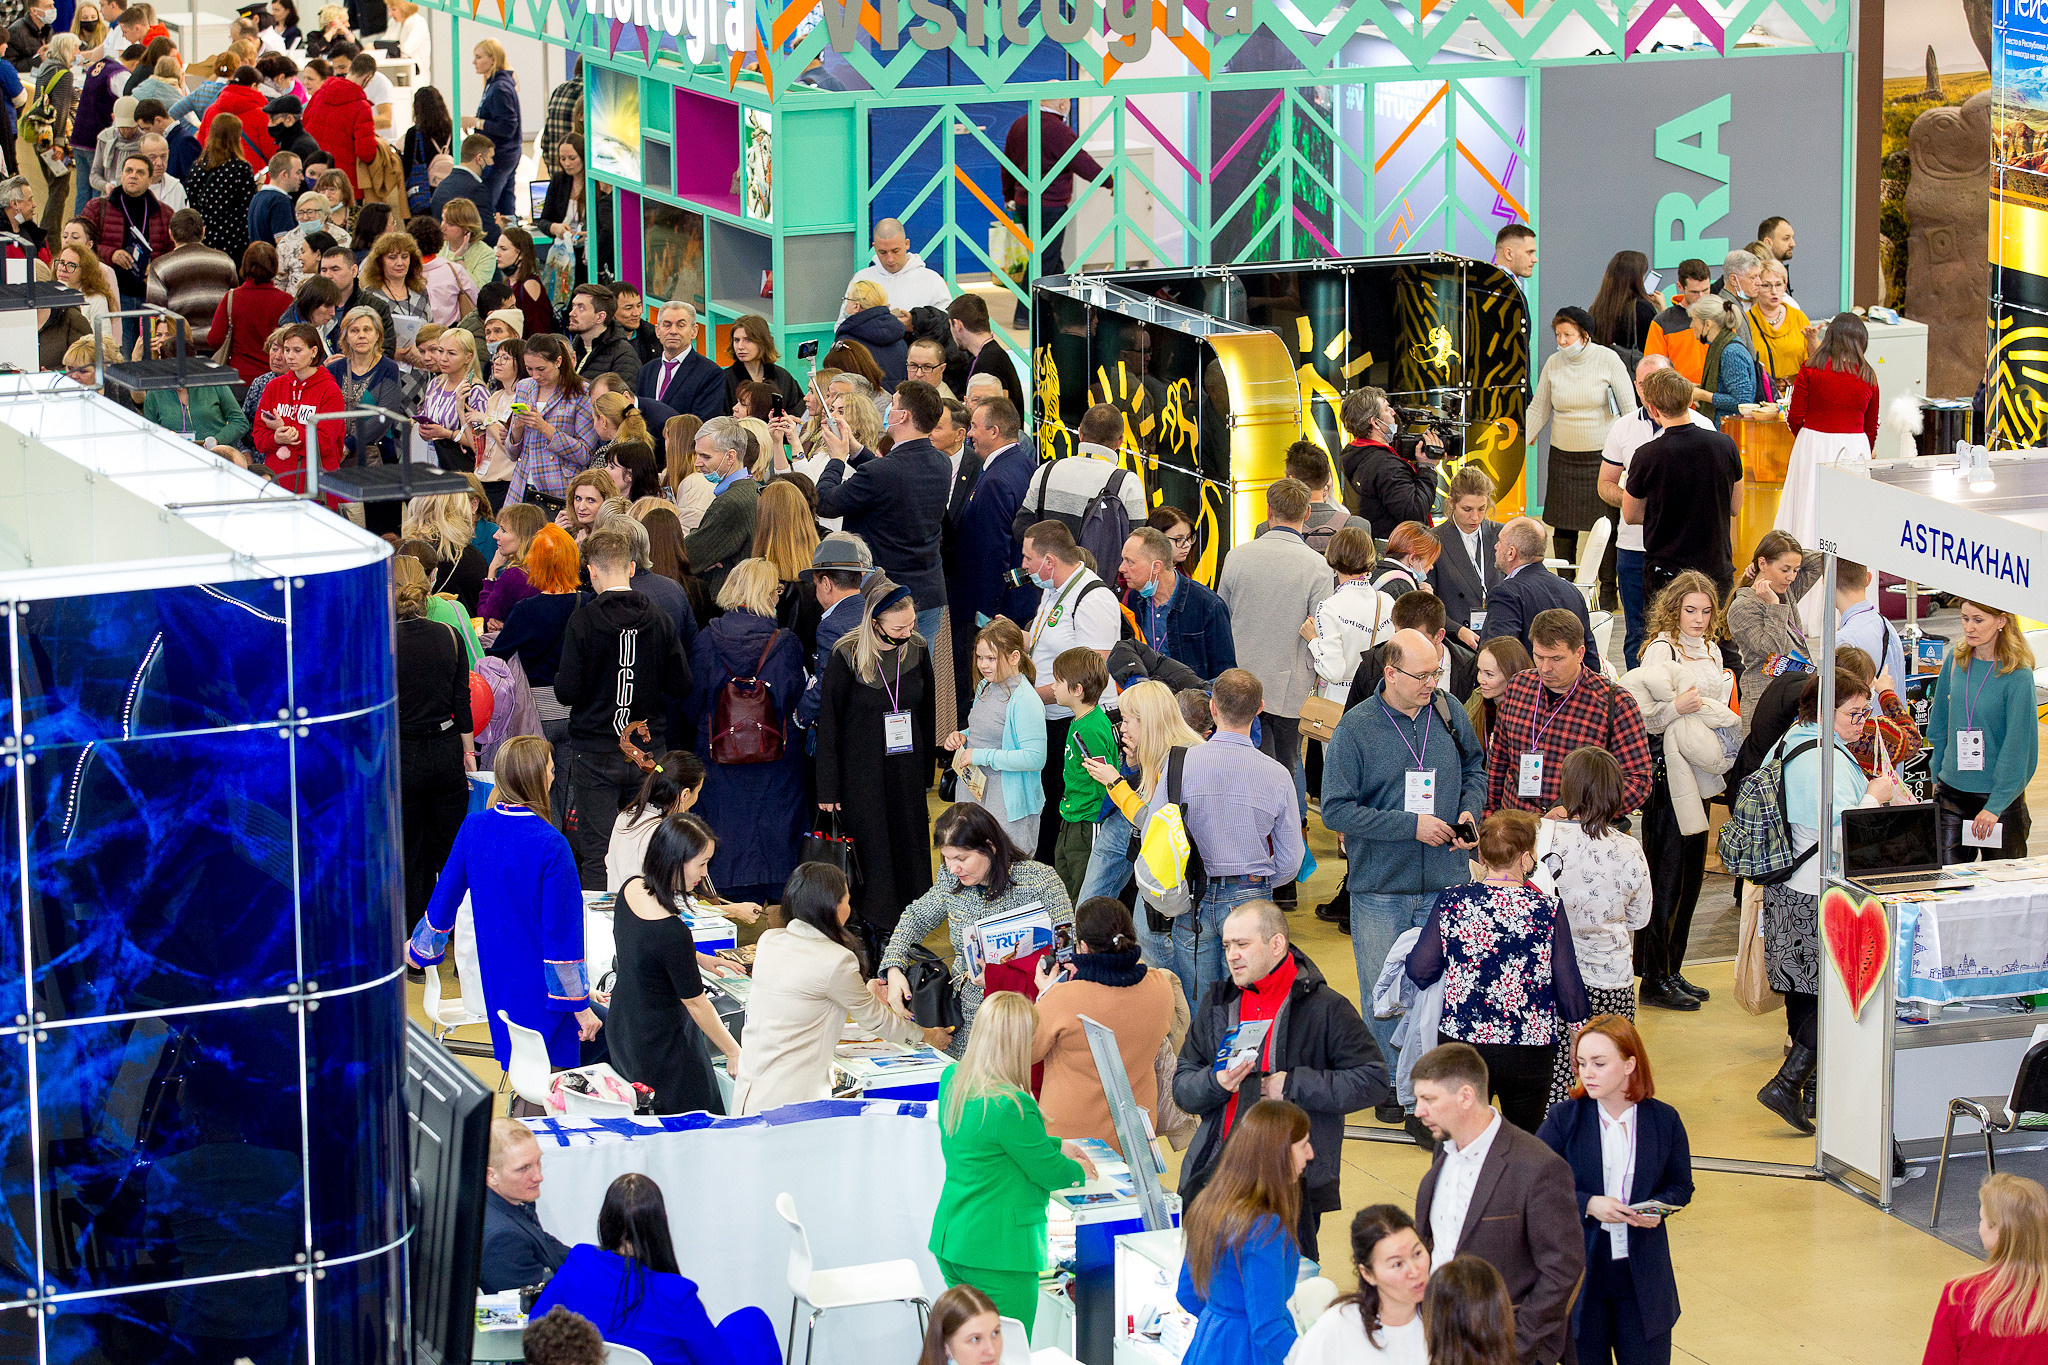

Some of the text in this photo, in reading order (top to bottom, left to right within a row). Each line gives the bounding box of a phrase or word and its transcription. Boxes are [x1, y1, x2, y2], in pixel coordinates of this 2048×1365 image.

[1654, 93, 1731, 300] RA
[1819, 538, 1837, 554] B502
[1900, 520, 2030, 588] ASTRAKHAN
